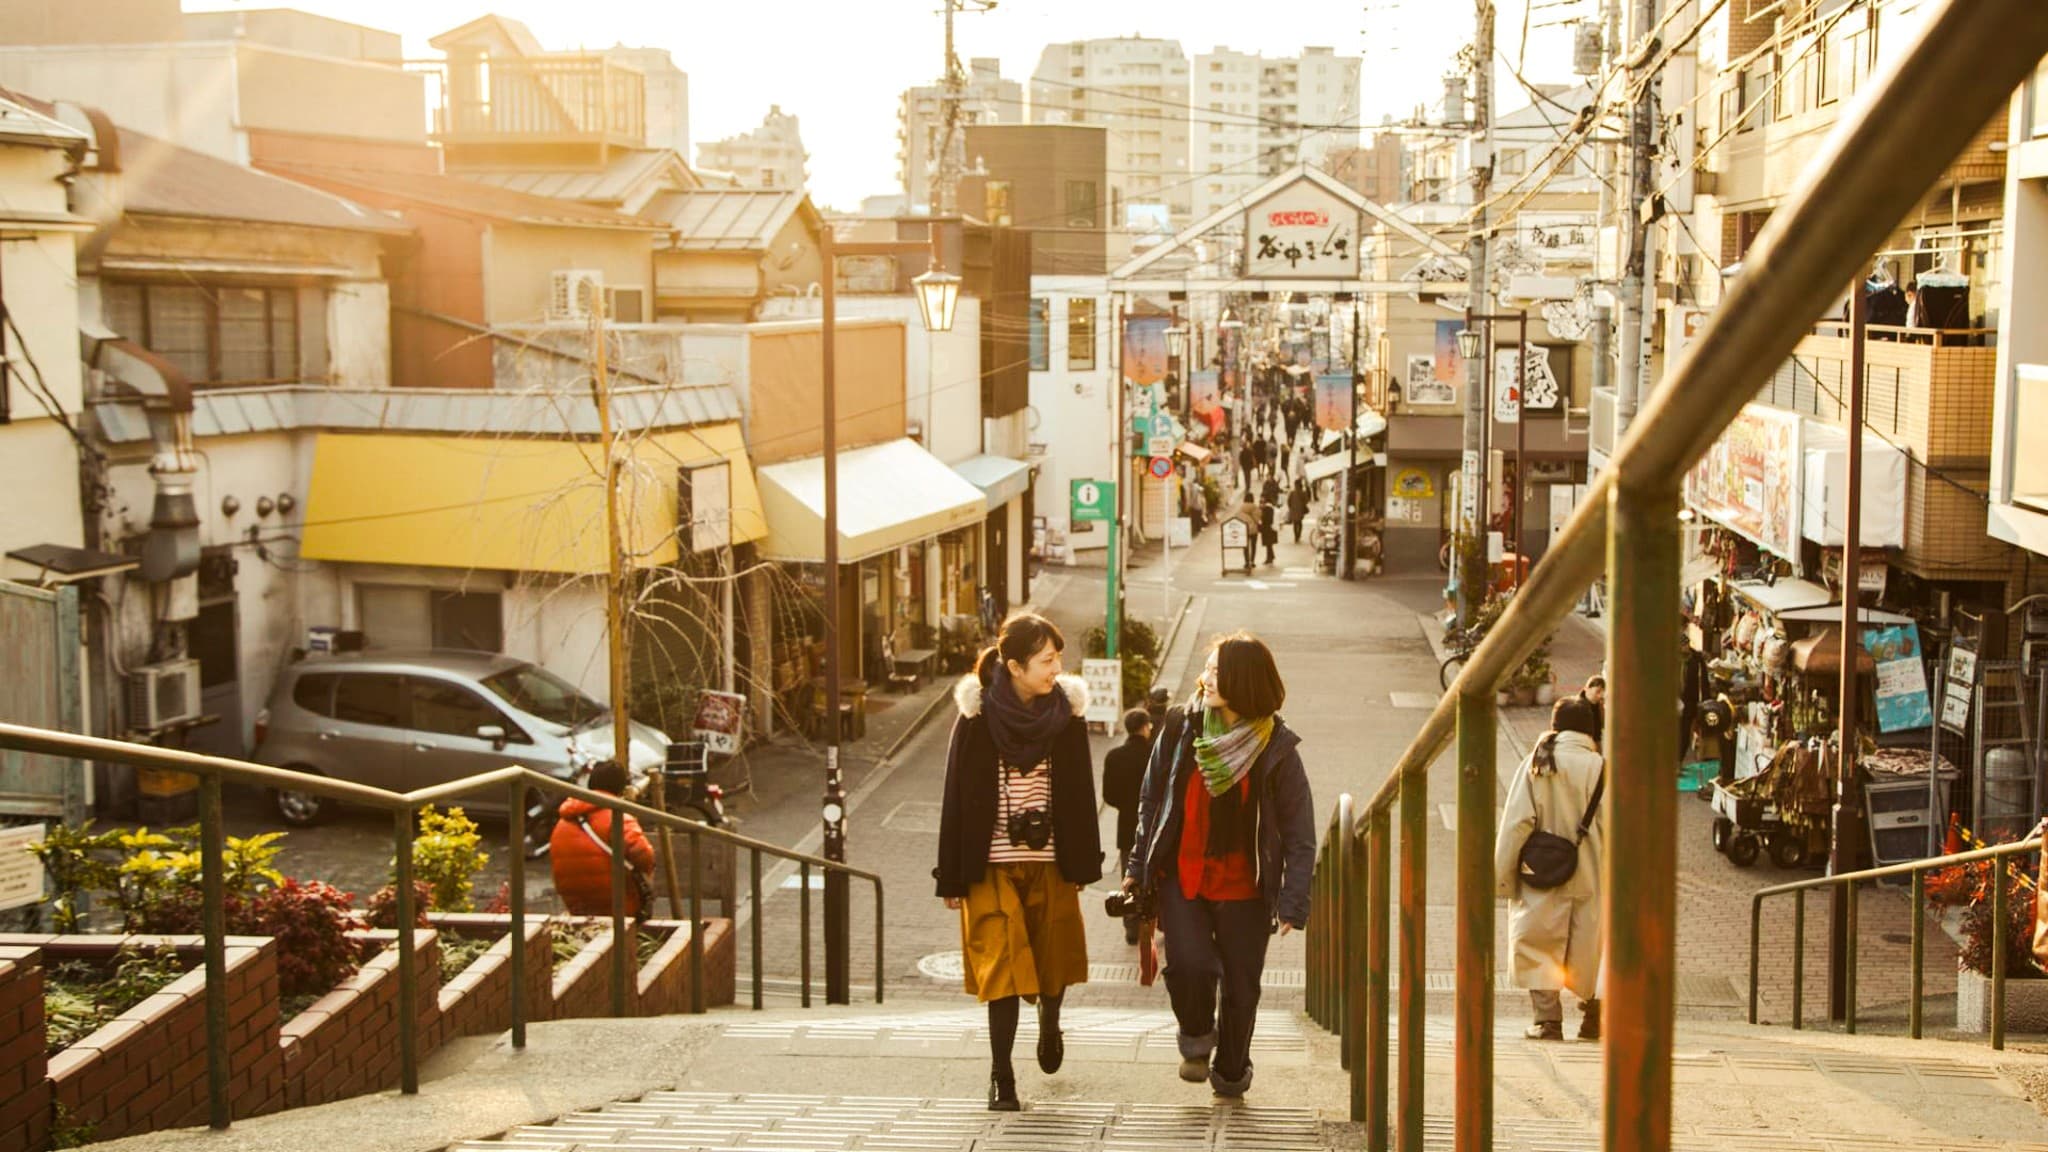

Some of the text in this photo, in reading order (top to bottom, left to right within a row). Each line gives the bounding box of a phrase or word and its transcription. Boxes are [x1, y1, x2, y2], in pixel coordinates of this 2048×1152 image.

[1256, 223, 1350, 269] 谷中ぎんざ
